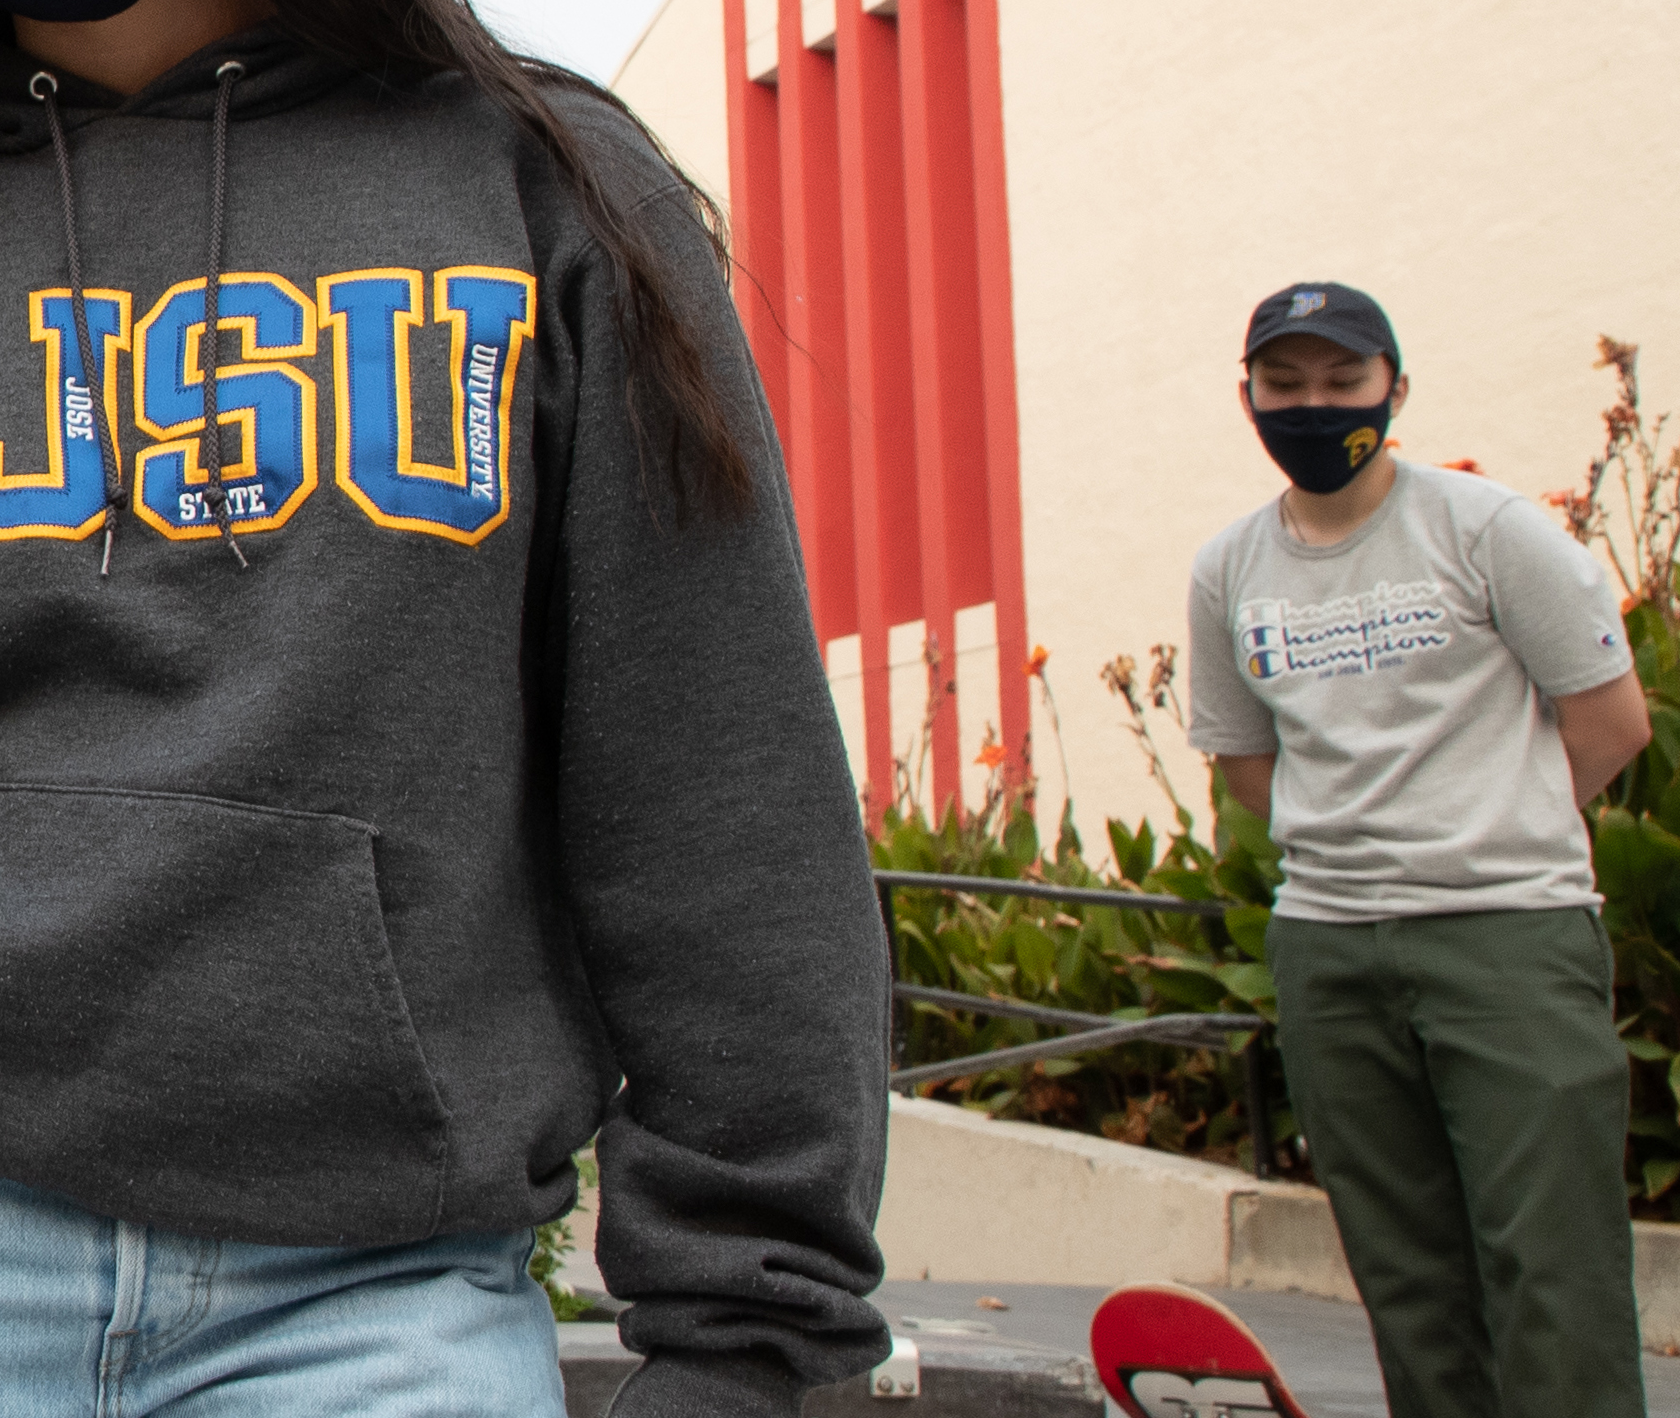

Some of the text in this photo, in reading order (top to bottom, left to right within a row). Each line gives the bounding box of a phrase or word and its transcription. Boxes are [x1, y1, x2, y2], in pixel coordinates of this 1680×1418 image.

[65, 376, 94, 441] JOSE
[468, 343, 499, 501] UNIVERSITY
[1242, 608, 1442, 650] Champion
[1248, 633, 1448, 679] Champion
